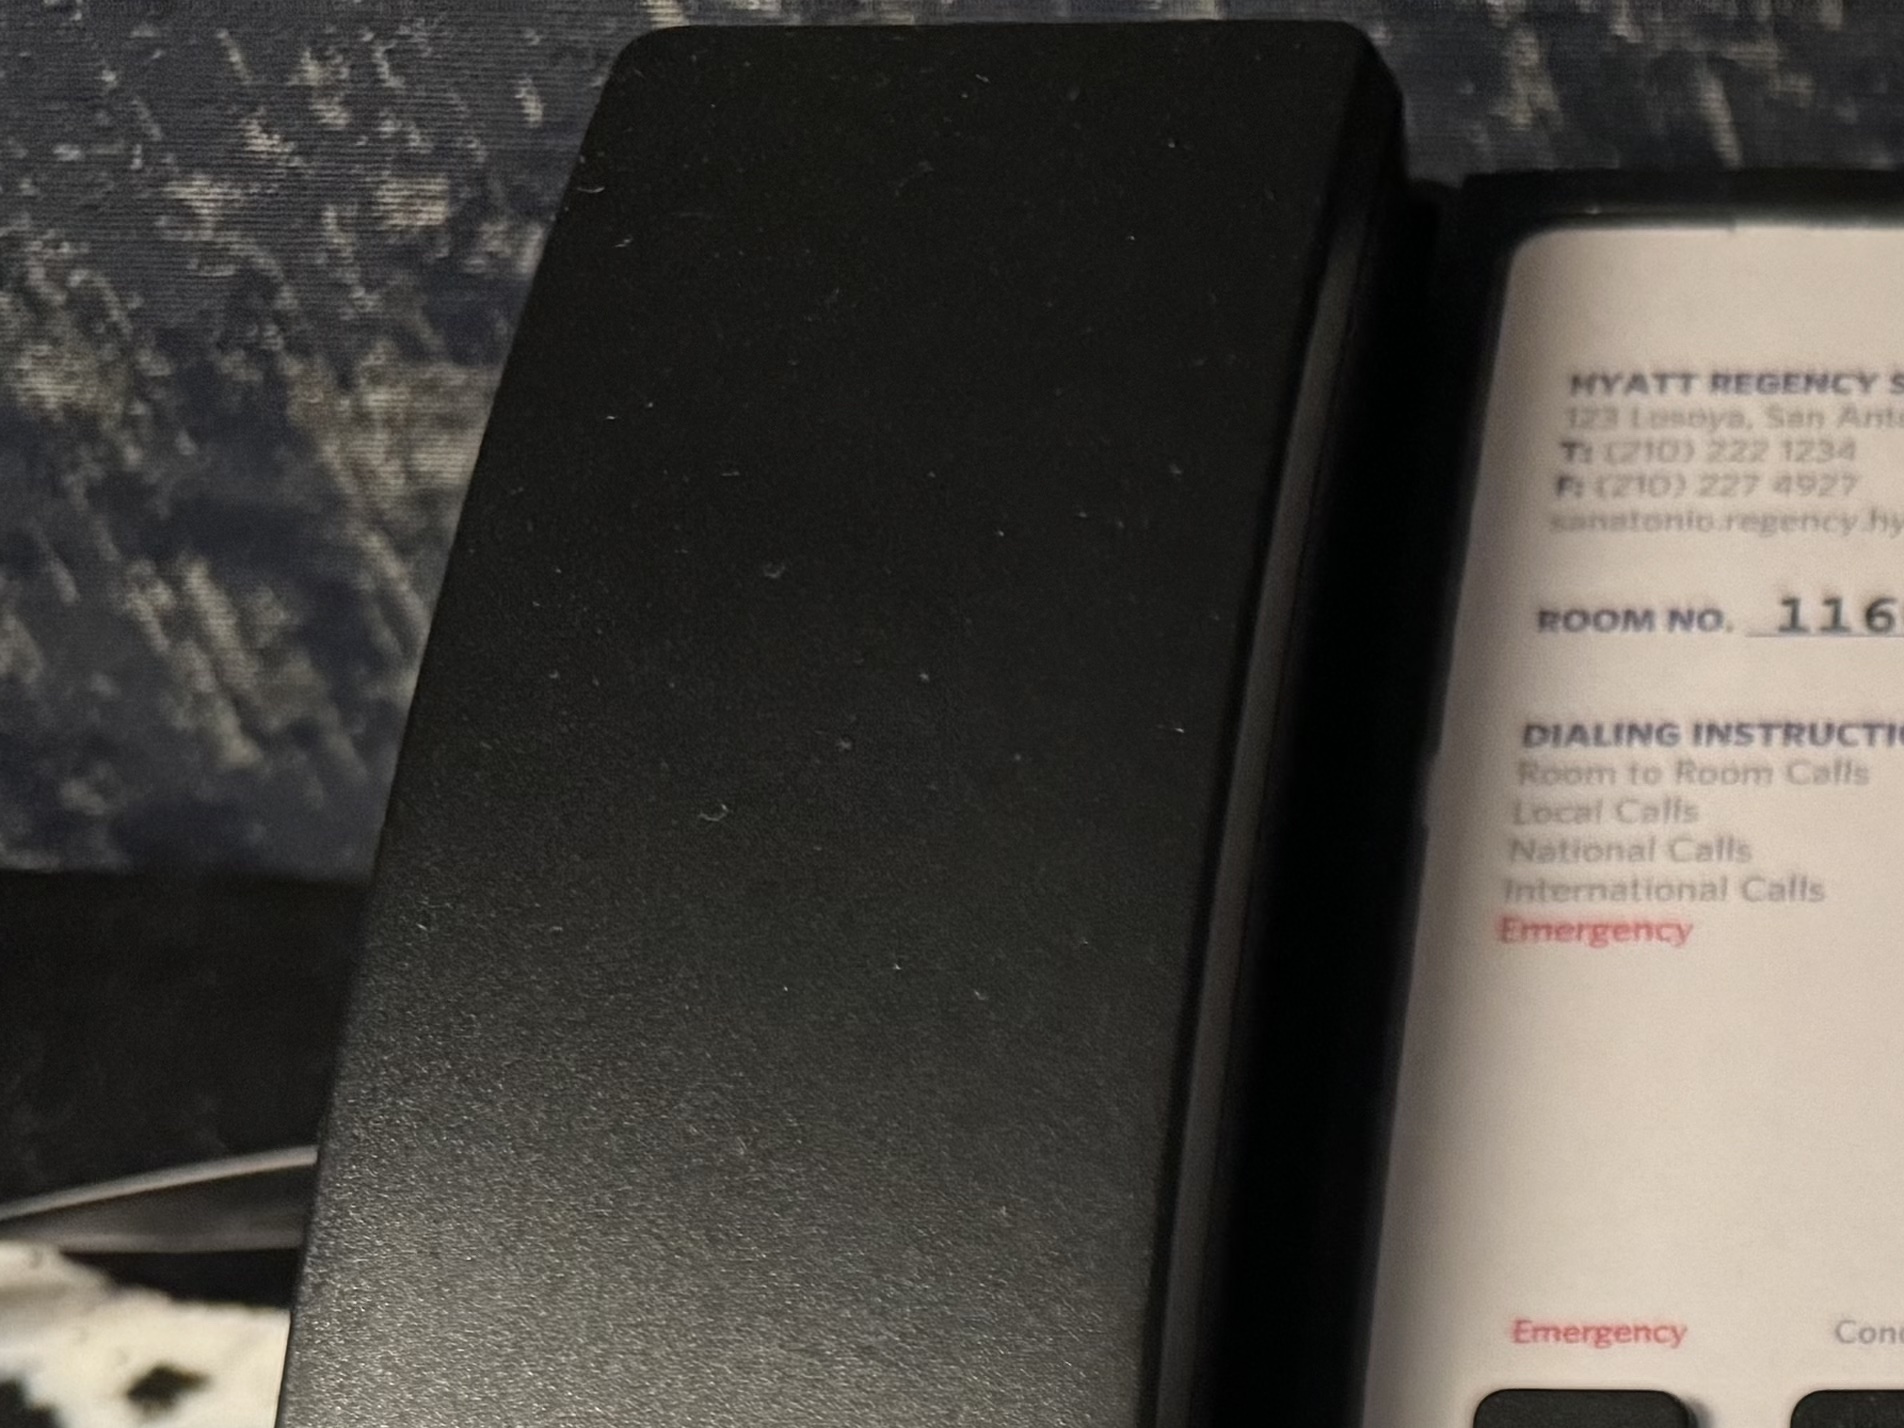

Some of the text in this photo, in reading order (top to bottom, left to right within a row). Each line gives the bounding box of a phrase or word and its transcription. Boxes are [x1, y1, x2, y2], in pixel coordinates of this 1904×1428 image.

[1570, 374, 1697, 396] HYATT
[1710, 374, 1877, 396] REGENCY
[1764, 408, 1826, 430] San
[1561, 441, 1857, 467] T: (210) 222 1234
[1557, 476, 1585, 497] F:
[1594, 475, 1688, 501] (210)
[1699, 476, 1761, 497] 227
[1537, 609, 1656, 633] ROOM
[1668, 609, 1734, 633] NO.
[1523, 724, 1681, 748] DIALING
[1518, 761, 1870, 786] Room to Room Calls
[1512, 800, 1699, 825] Local Calls
[1508, 839, 1753, 863] National Calls
[1503, 878, 1825, 902] International Calls
[1499, 917, 1693, 946] Emergency
[1512, 1320, 1688, 1347] Emergency
